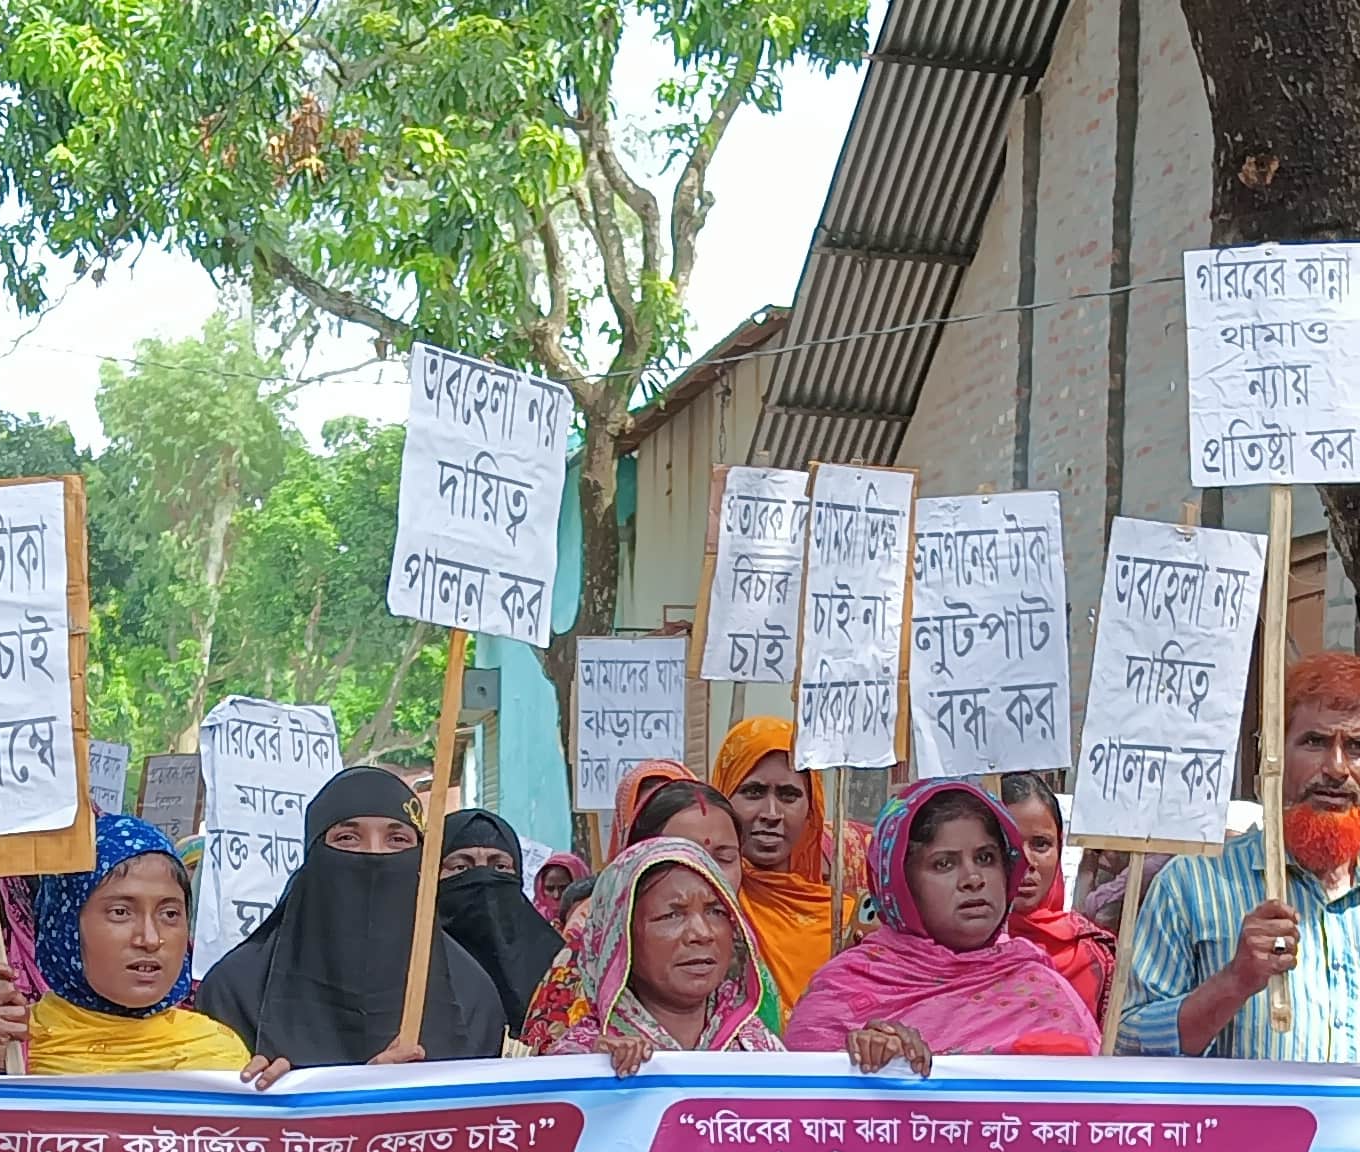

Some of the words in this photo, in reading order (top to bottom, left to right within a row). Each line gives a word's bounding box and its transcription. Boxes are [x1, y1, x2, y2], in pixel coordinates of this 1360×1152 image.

[1197, 249, 1287, 302] গরিবের
[1296, 252, 1351, 303] কান্না
[1220, 319, 1328, 350] থামাও
[424, 347, 521, 440] অবহেলা
[529, 379, 564, 450] নয়
[1245, 362, 1312, 408] ন্যায়
[1306, 429, 1356, 470] কর
[438, 451, 533, 546] দায়িত্ব
[913, 528, 999, 588] জনগনের
[1003, 507, 1053, 586] টাকা
[405, 547, 490, 632] পালন
[499, 571, 545, 640] কর
[732, 554, 792, 605] বিচার
[811, 576, 853, 642] চাই
[860, 592, 892, 640] না
[1115, 554, 1209, 631] অবহেলা
[1215, 567, 1249, 631] নয়
[728, 618, 792, 682] চাই
[911, 590, 1055, 679] লুটপাট
[580, 656, 650, 694] আমাদের
[1125, 639, 1216, 722] দায়িত্ব
[288, 711, 335, 771] টাকা
[930, 686, 990, 750] বন্ধ
[1001, 682, 1058, 743] কর
[234, 784, 307, 817] মানে
[581, 750, 610, 792] টাকা
[1089, 736, 1172, 801] পালন
[1181, 747, 1225, 804] কর
[208, 829, 250, 871] রক্ত
[679, 1112, 791, 1147] “গরিবের
[803, 1119, 844, 1144] ঘাম
[855, 1117, 898, 1145] ঝরা
[910, 1114, 971, 1146] টাকা
[981, 1114, 1019, 1151] লুট
[1031, 1119, 1078, 1146] করা
[1089, 1119, 1154, 1146] চলবে
